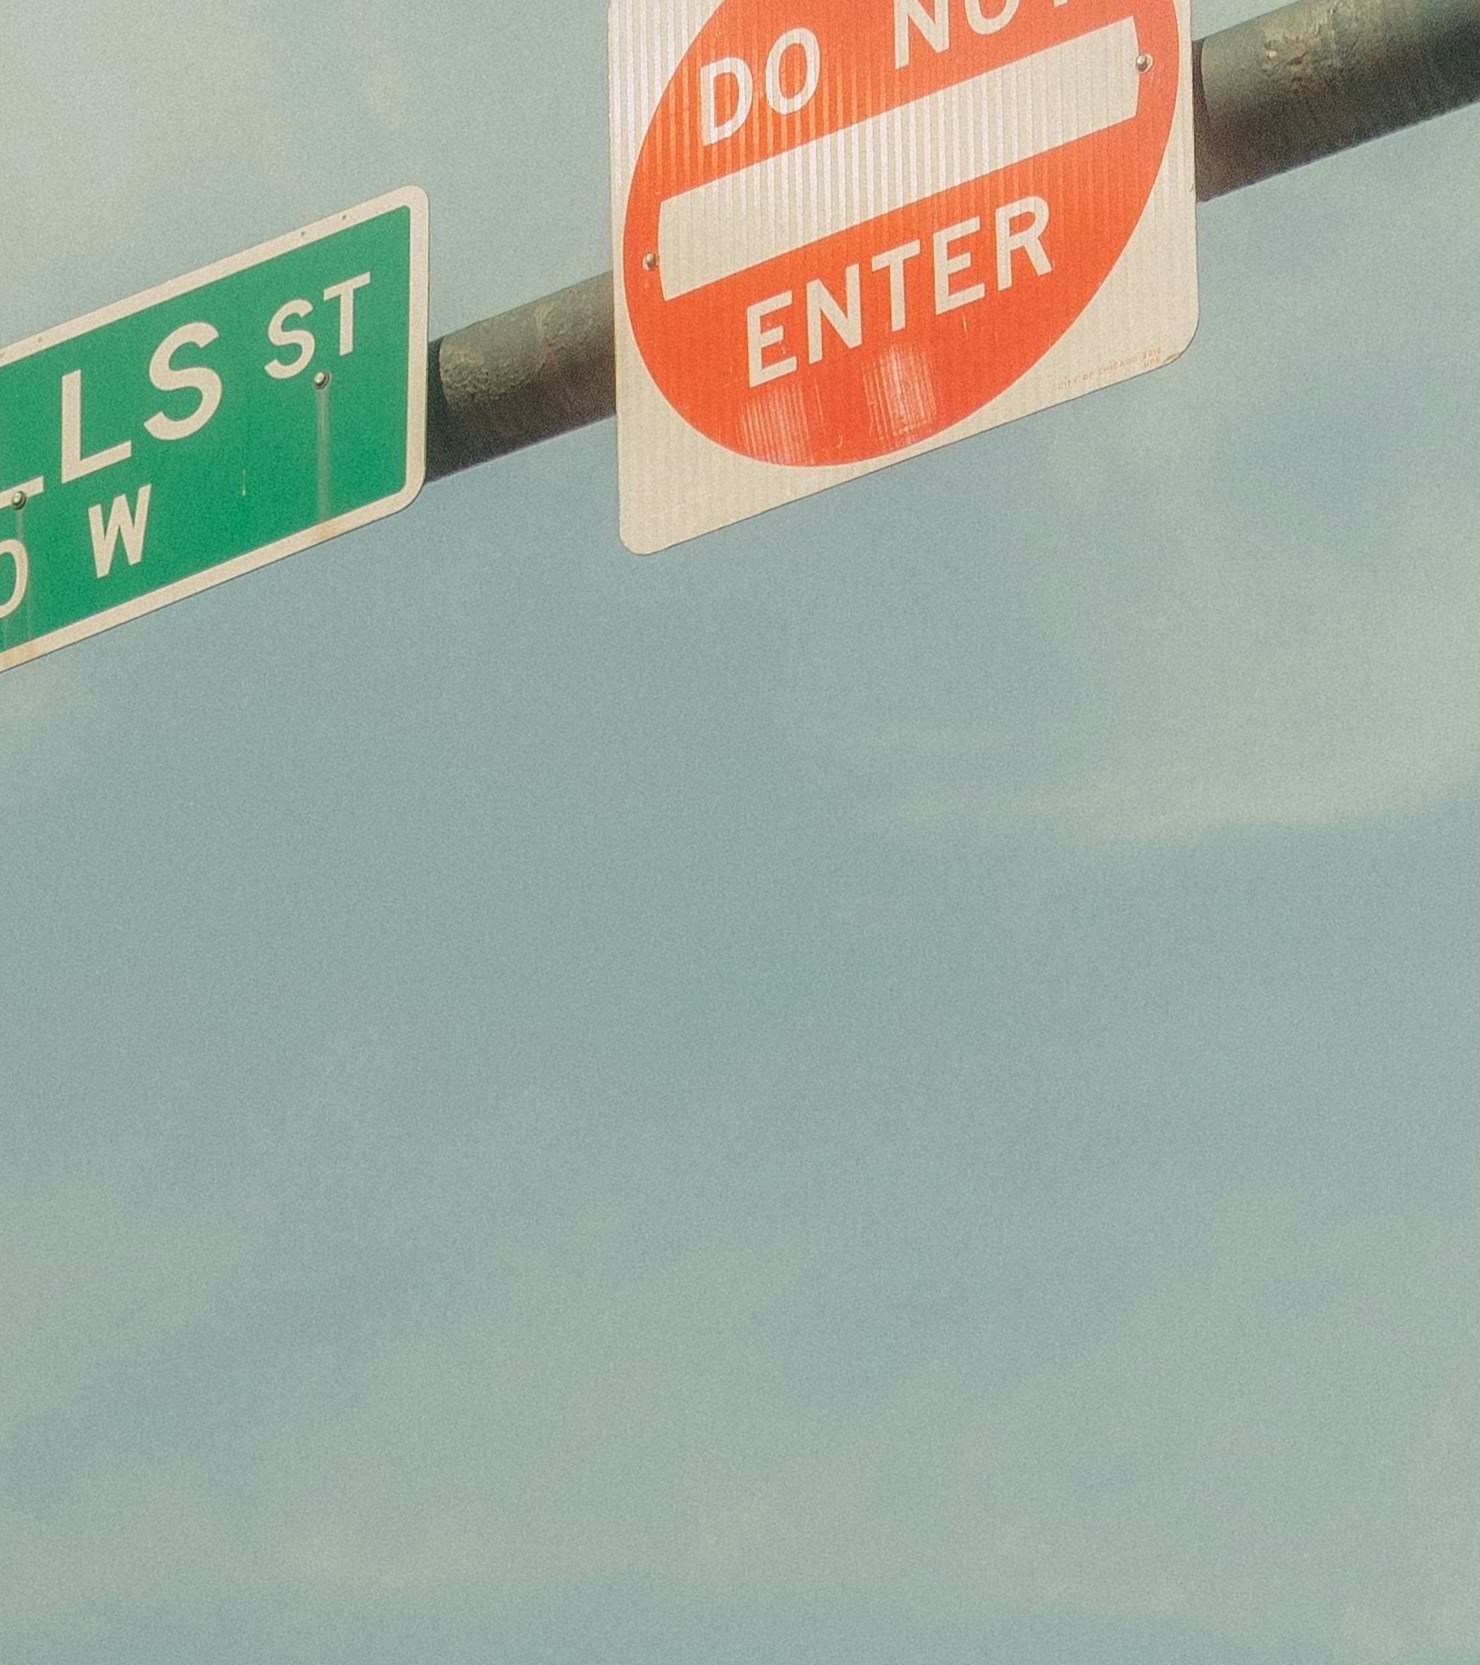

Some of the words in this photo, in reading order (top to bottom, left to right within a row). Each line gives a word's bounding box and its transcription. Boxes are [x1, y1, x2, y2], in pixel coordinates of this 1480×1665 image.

[699, 27, 820, 147] DO
[263, 271, 372, 380] ST
[745, 195, 1053, 389] ENTER
[87, 483, 153, 579] W
